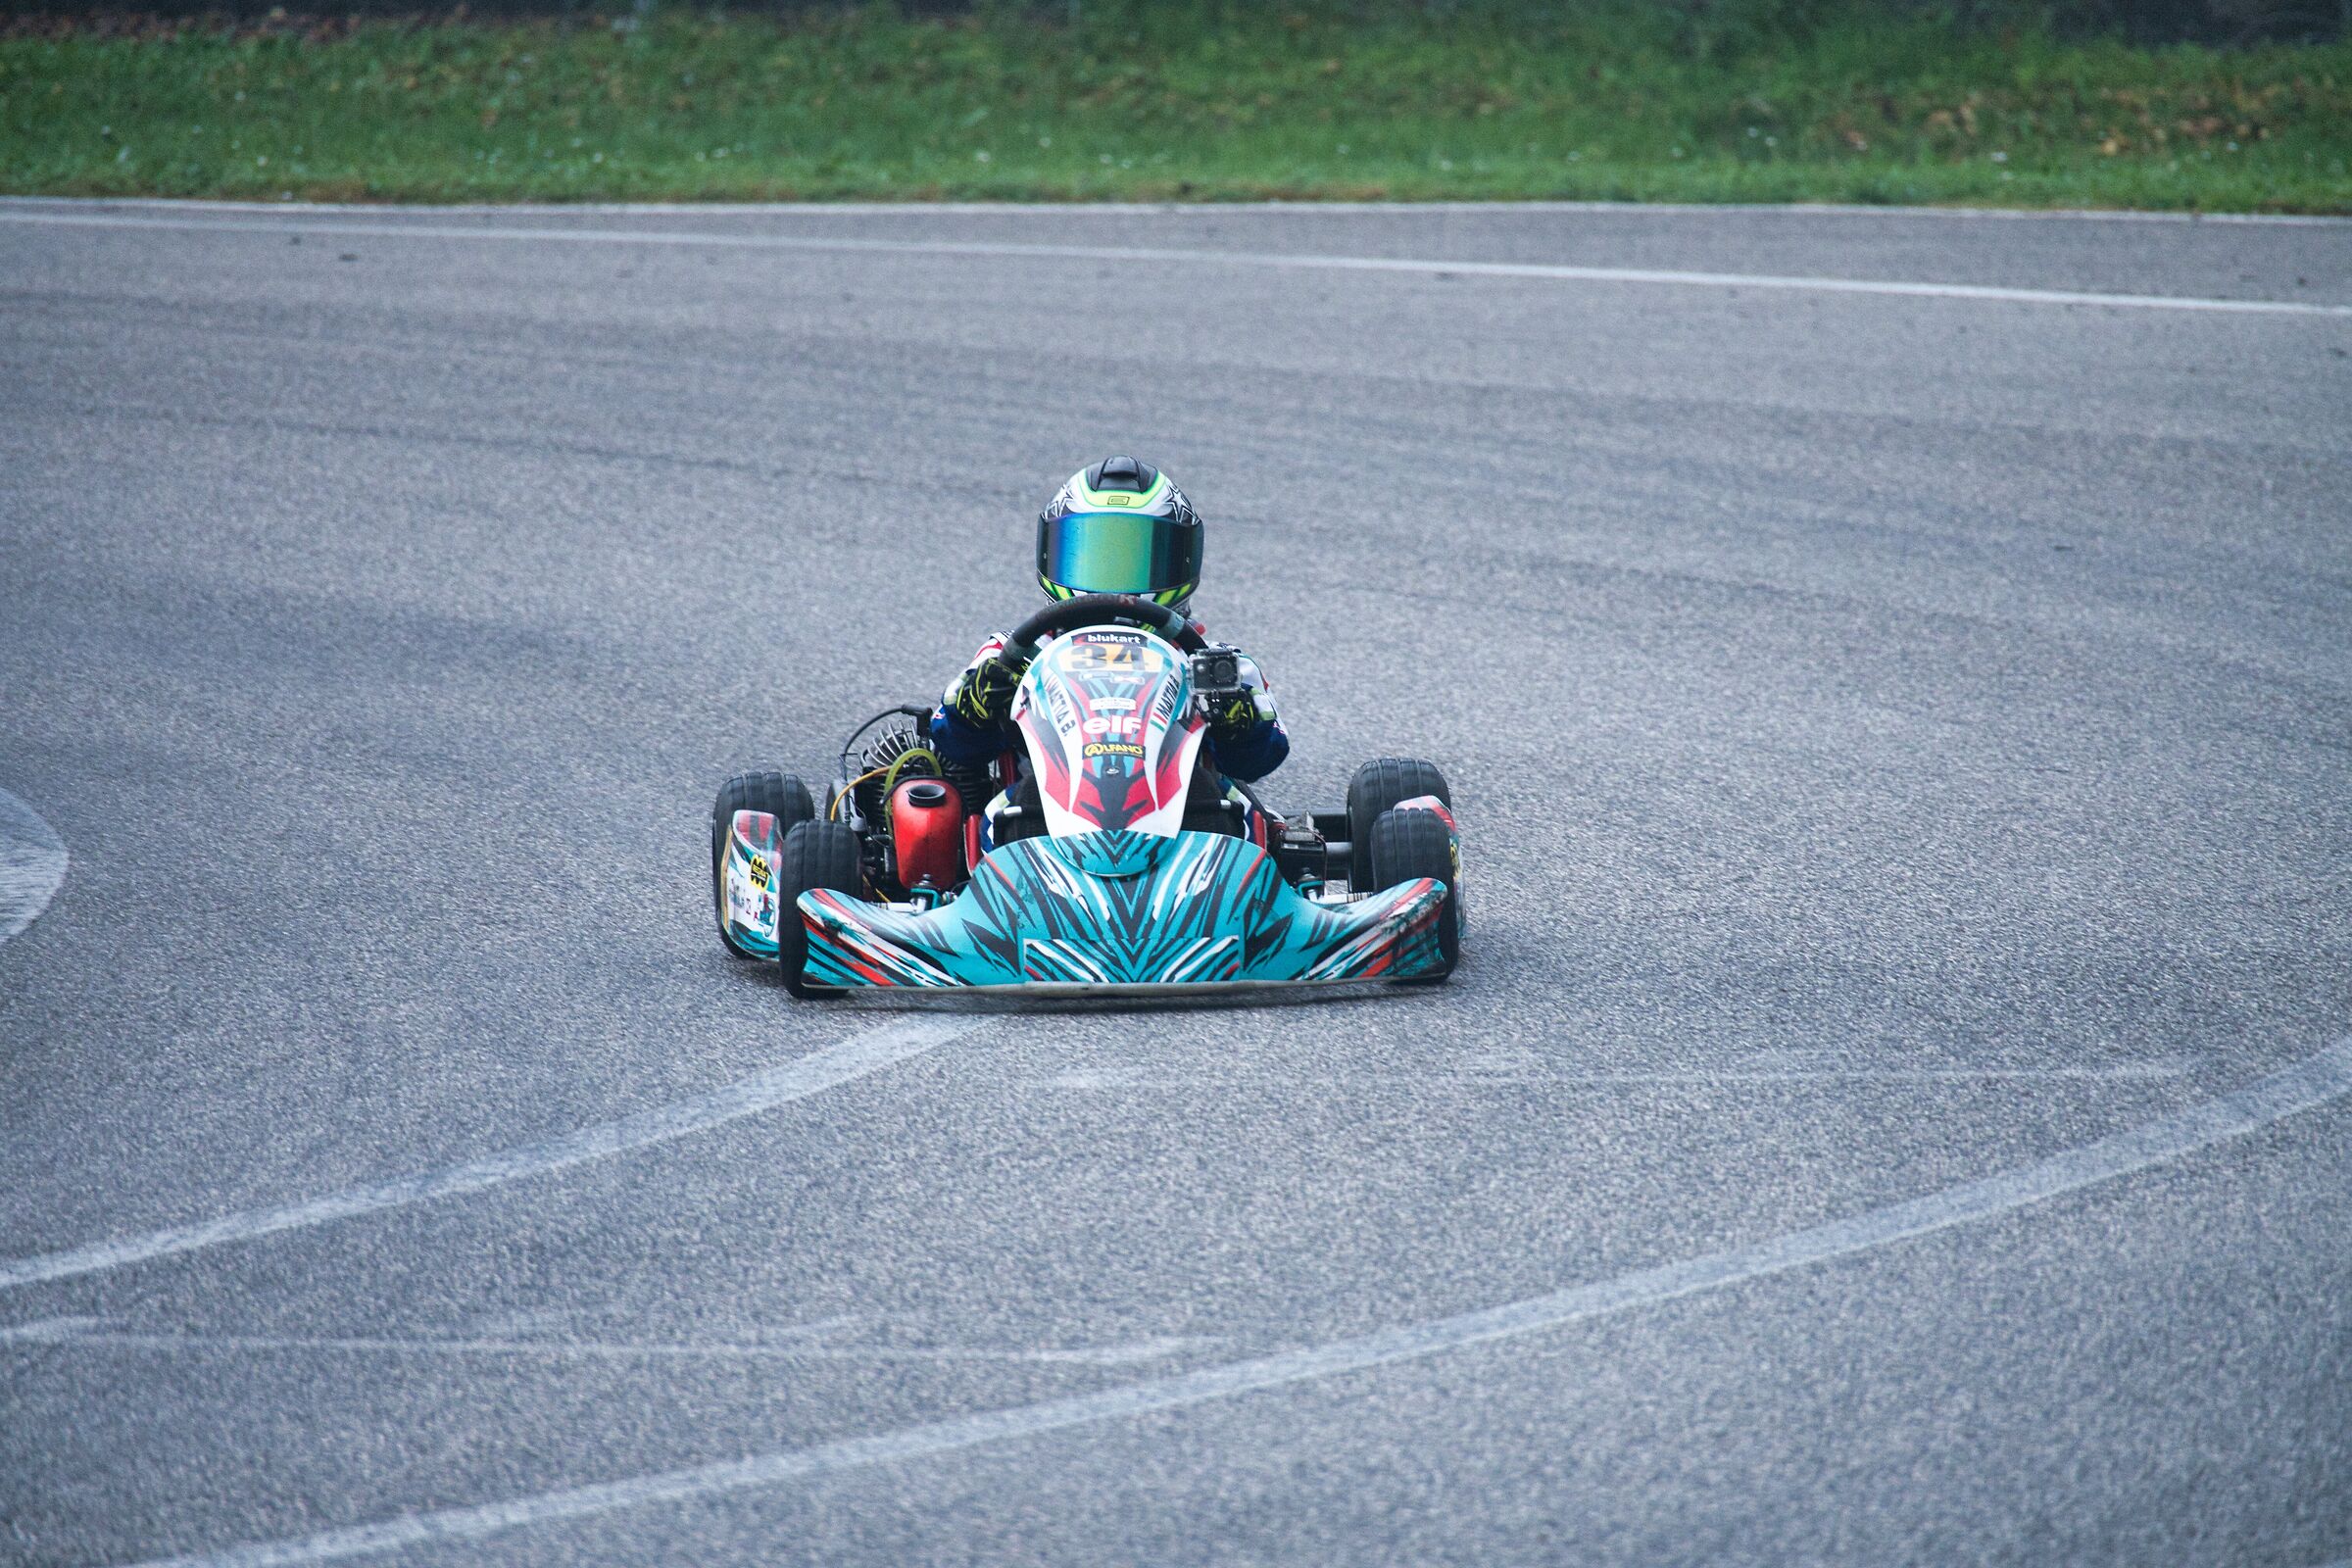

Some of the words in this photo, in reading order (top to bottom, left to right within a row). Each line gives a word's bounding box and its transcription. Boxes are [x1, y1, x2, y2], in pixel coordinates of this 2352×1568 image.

[1088, 634, 1141, 643] blukart
[1071, 644, 1146, 670] 34
[1083, 714, 1143, 735] elf
[1084, 743, 1143, 756] ALFANO
